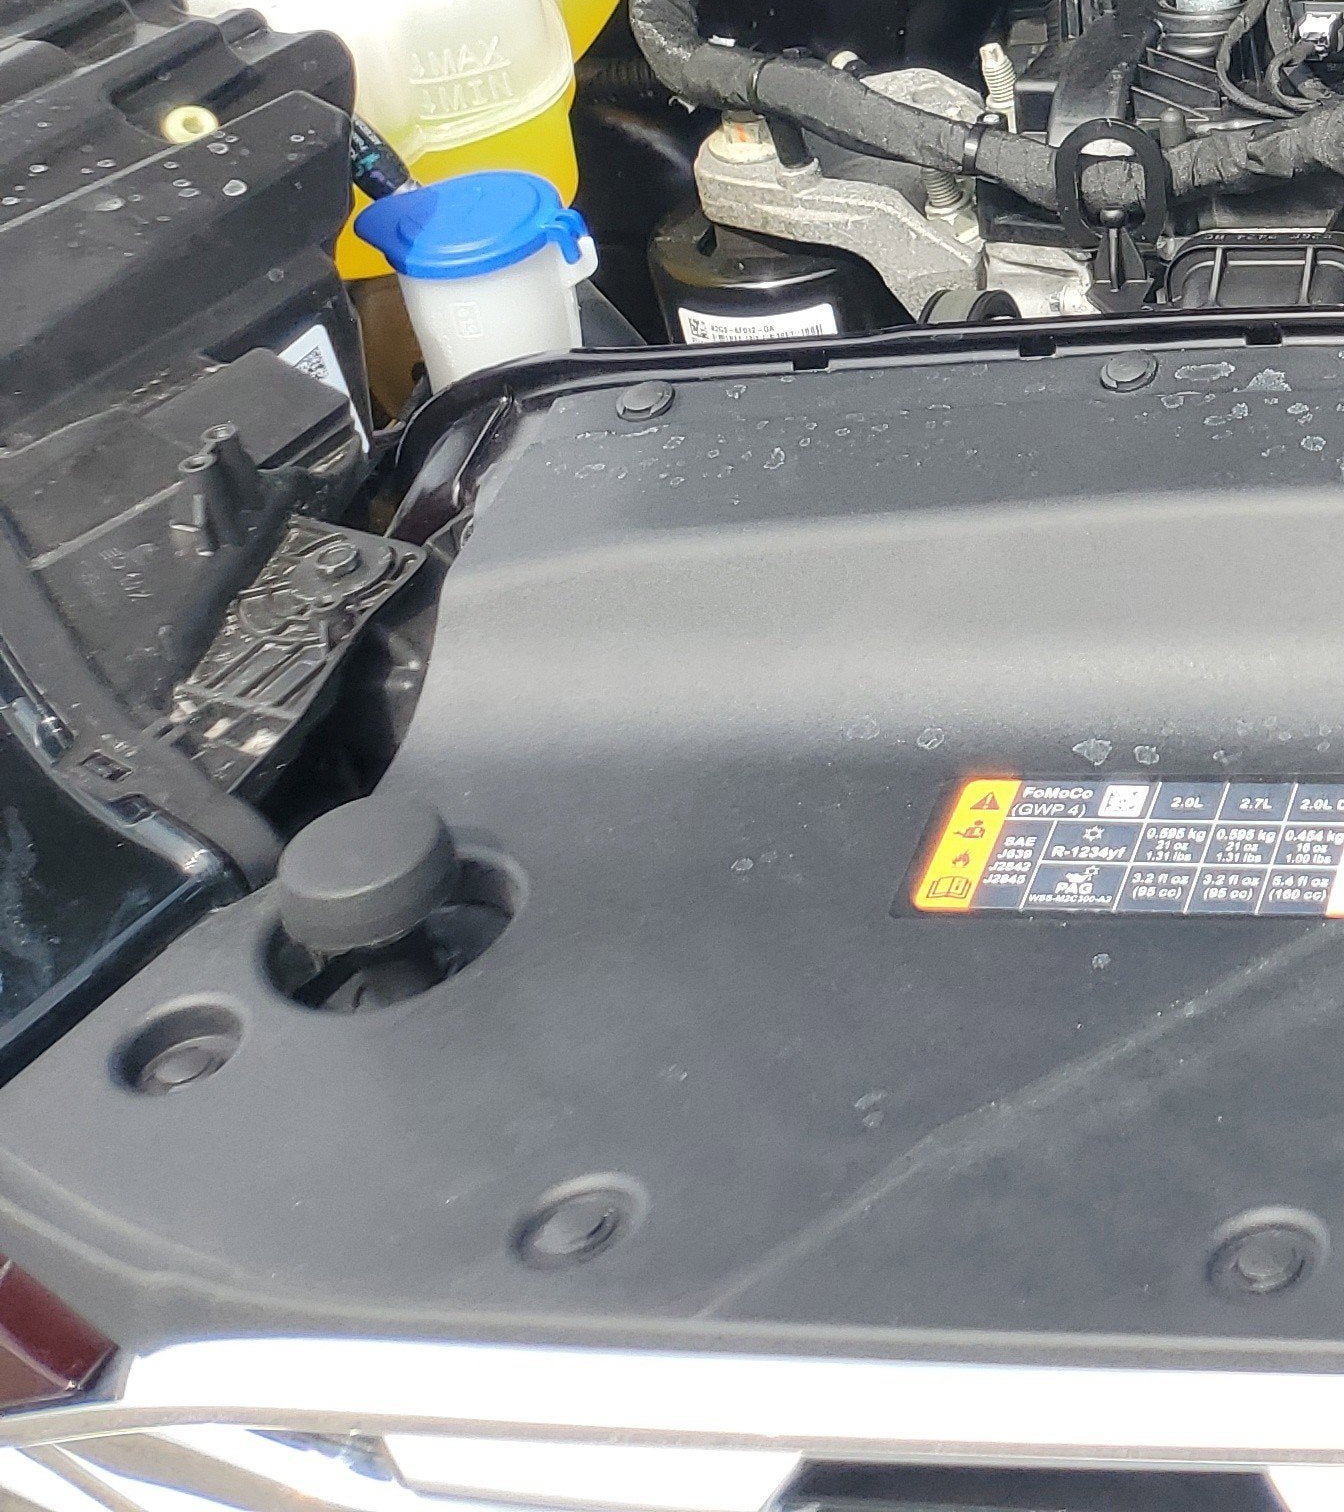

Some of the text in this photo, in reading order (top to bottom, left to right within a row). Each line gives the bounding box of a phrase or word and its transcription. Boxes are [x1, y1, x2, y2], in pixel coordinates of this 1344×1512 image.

[428, 35, 505, 77] MAX
[438, 72, 514, 112] MIN
[1022, 786, 1094, 799] FoMoCo
[1171, 796, 1204, 808] 2.0L
[1239, 797, 1272, 810] 2.7L
[1300, 799, 1333, 811] 2.0L
[1011, 803, 1086, 818] (GWP 4)
[1147, 827, 1207, 843] 0.595 kg
[1216, 828, 1277, 843] 0.595 kg
[1285, 829, 1344, 845] 0.454 kg
[1004, 836, 1037, 847] SAE
[1155, 840, 1189, 851] 21 oz
[1225, 841, 1259, 852] 21 oz
[1296, 842, 1328, 853] 16 oz
[997, 848, 1033, 859] J639
[1051, 845, 1126, 861] R-1234yf
[1146, 851, 1191, 862] 1.31 lbs
[1216, 852, 1262, 863] 1.31 lbs
[1313, 853, 1331, 864] lbs
[1132, 873, 1190, 885] 3.2 fl oz
[1203, 874, 1261, 886] 3.2 fl oz
[1272, 875, 1330, 887] 5.4 fl oz
[1055, 882, 1093, 894] PAG
[1132, 886, 1181, 899] (95 cc)
[1203, 887, 1253, 900] (95 cc)
[1303, 889, 1327, 902] cc)
